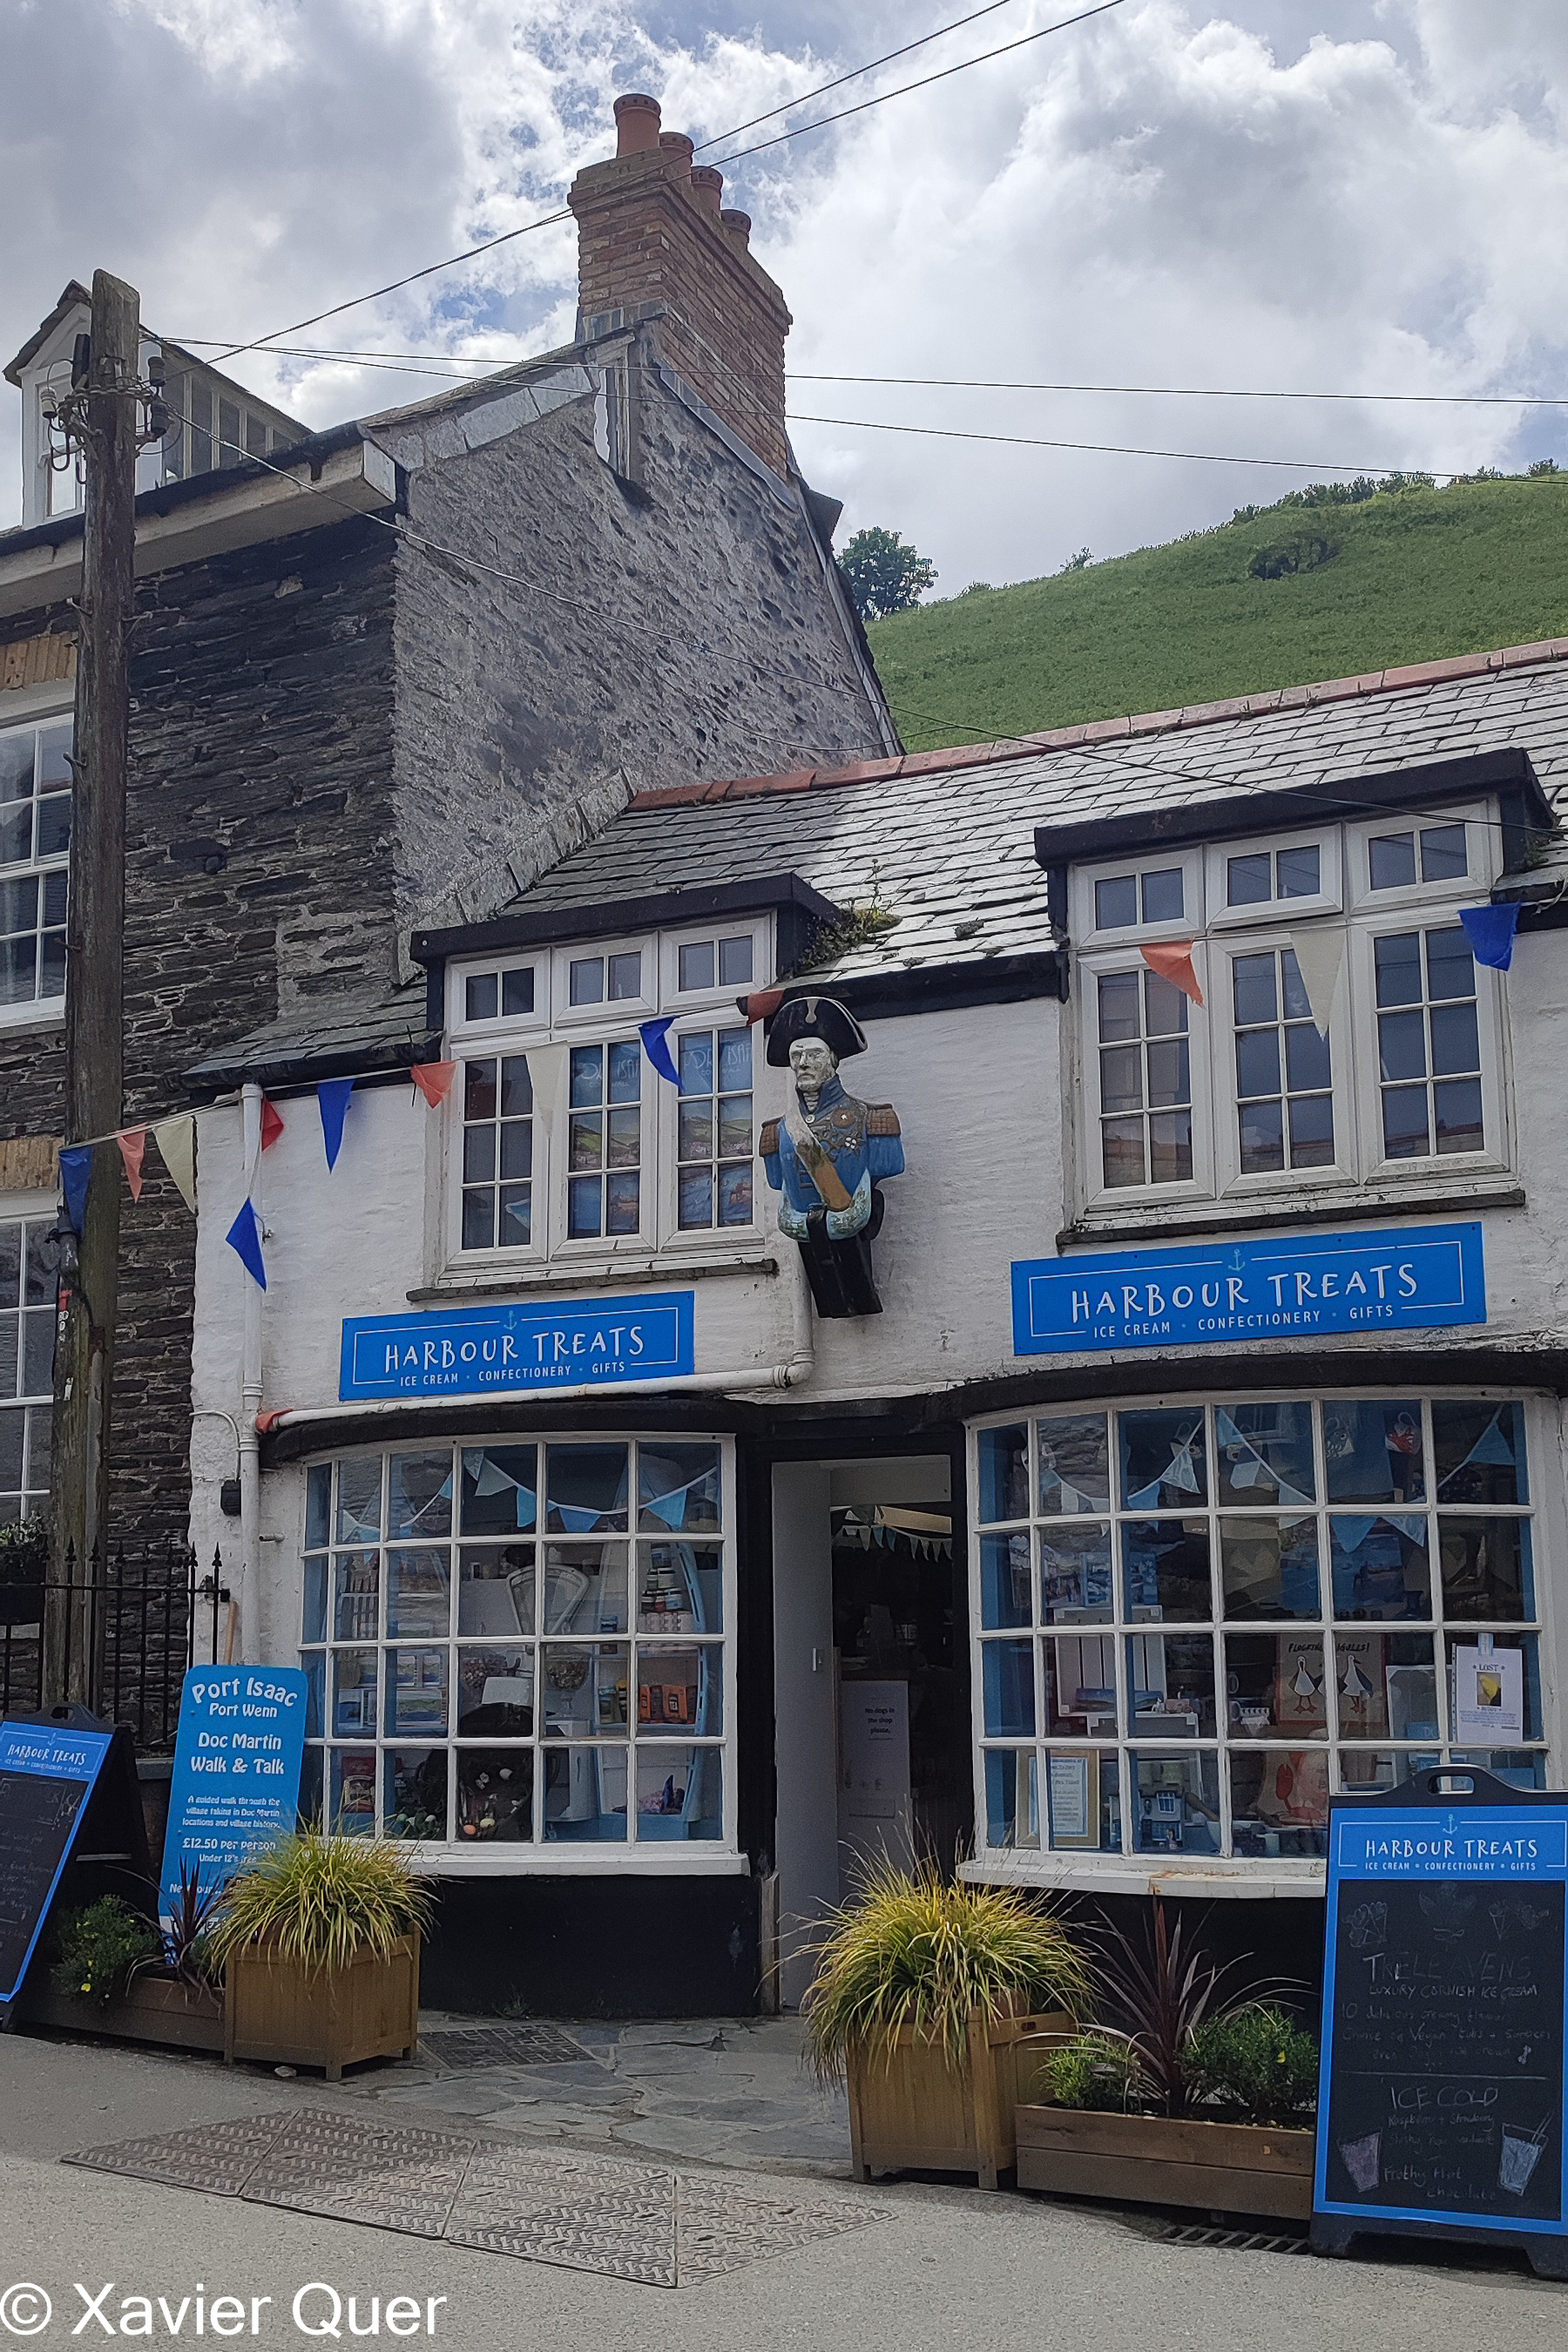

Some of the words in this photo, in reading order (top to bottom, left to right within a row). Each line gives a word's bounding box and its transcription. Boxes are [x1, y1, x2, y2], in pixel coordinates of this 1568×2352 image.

[1071, 1277, 1249, 1323] HARBOUR
[1267, 1263, 1418, 1306] TREATS
[1093, 1326, 1116, 1339] ICE
[1124, 1321, 1171, 1336] CREAM
[1198, 1311, 1321, 1331] CONFECTIONERY
[1349, 1305, 1394, 1320] GIFTS
[384, 1335, 519, 1373] HARBOUR
[532, 1325, 645, 1362] TREATS
[400, 1375, 420, 1387] ICE
[422, 1372, 459, 1385] CREAM
[478, 1364, 571, 1382] CONFECTIONERY
[591, 1361, 625, 1374] GIFTS
[192, 1678, 240, 1704] Port
[246, 1677, 298, 1707] Isaac
[209, 1702, 239, 1716] Port
[242, 1703, 278, 1718] Wenn
[669, 1700, 679, 1711] TEA
[198, 1732, 228, 1748] Doc
[232, 1733, 282, 1750] Martin
[7, 1744, 50, 1761] HARBOUR
[52, 1750, 86, 1766] TREATS
[191, 1756, 226, 1773] Walk
[232, 1757, 248, 1774] &
[253, 1758, 285, 1774] Talk
[195, 1796, 220, 1805] guided
[220, 1796, 237, 1805] walk
[186, 1807, 208, 1815] village
[210, 1808, 232, 1816] taking
[182, 1818, 213, 1827] locations
[253, 1820, 280, 1828] history.
[182, 1837, 218, 1849] £12.50
[220, 1841, 238, 1850] per
[240, 1841, 276, 1851] person
[1365, 1839, 1456, 1859] HARBOUR
[1464, 1839, 1539, 1859] TREATS
[199, 1853, 223, 1862] Under
[1365, 1862, 1378, 1870] ICE
[1382, 1862, 1410, 1870] CREAM
[1424, 1862, 1496, 1871] CONFECTIONERY
[1511, 1862, 1537, 1871] GIFTS
[1369, 1984, 1416, 1999] LUXURY
[1420, 1984, 1475, 1999] CORNISH
[1481, 1985, 1497, 1998] ICE
[1500, 1984, 1538, 2000] CREAM
[1342, 2003, 1357, 2018] 10
[1390, 2085, 1431, 2111] ICE
[1437, 2085, 1498, 2107] COLD
[1384, 2164, 1426, 2187] Frothy
